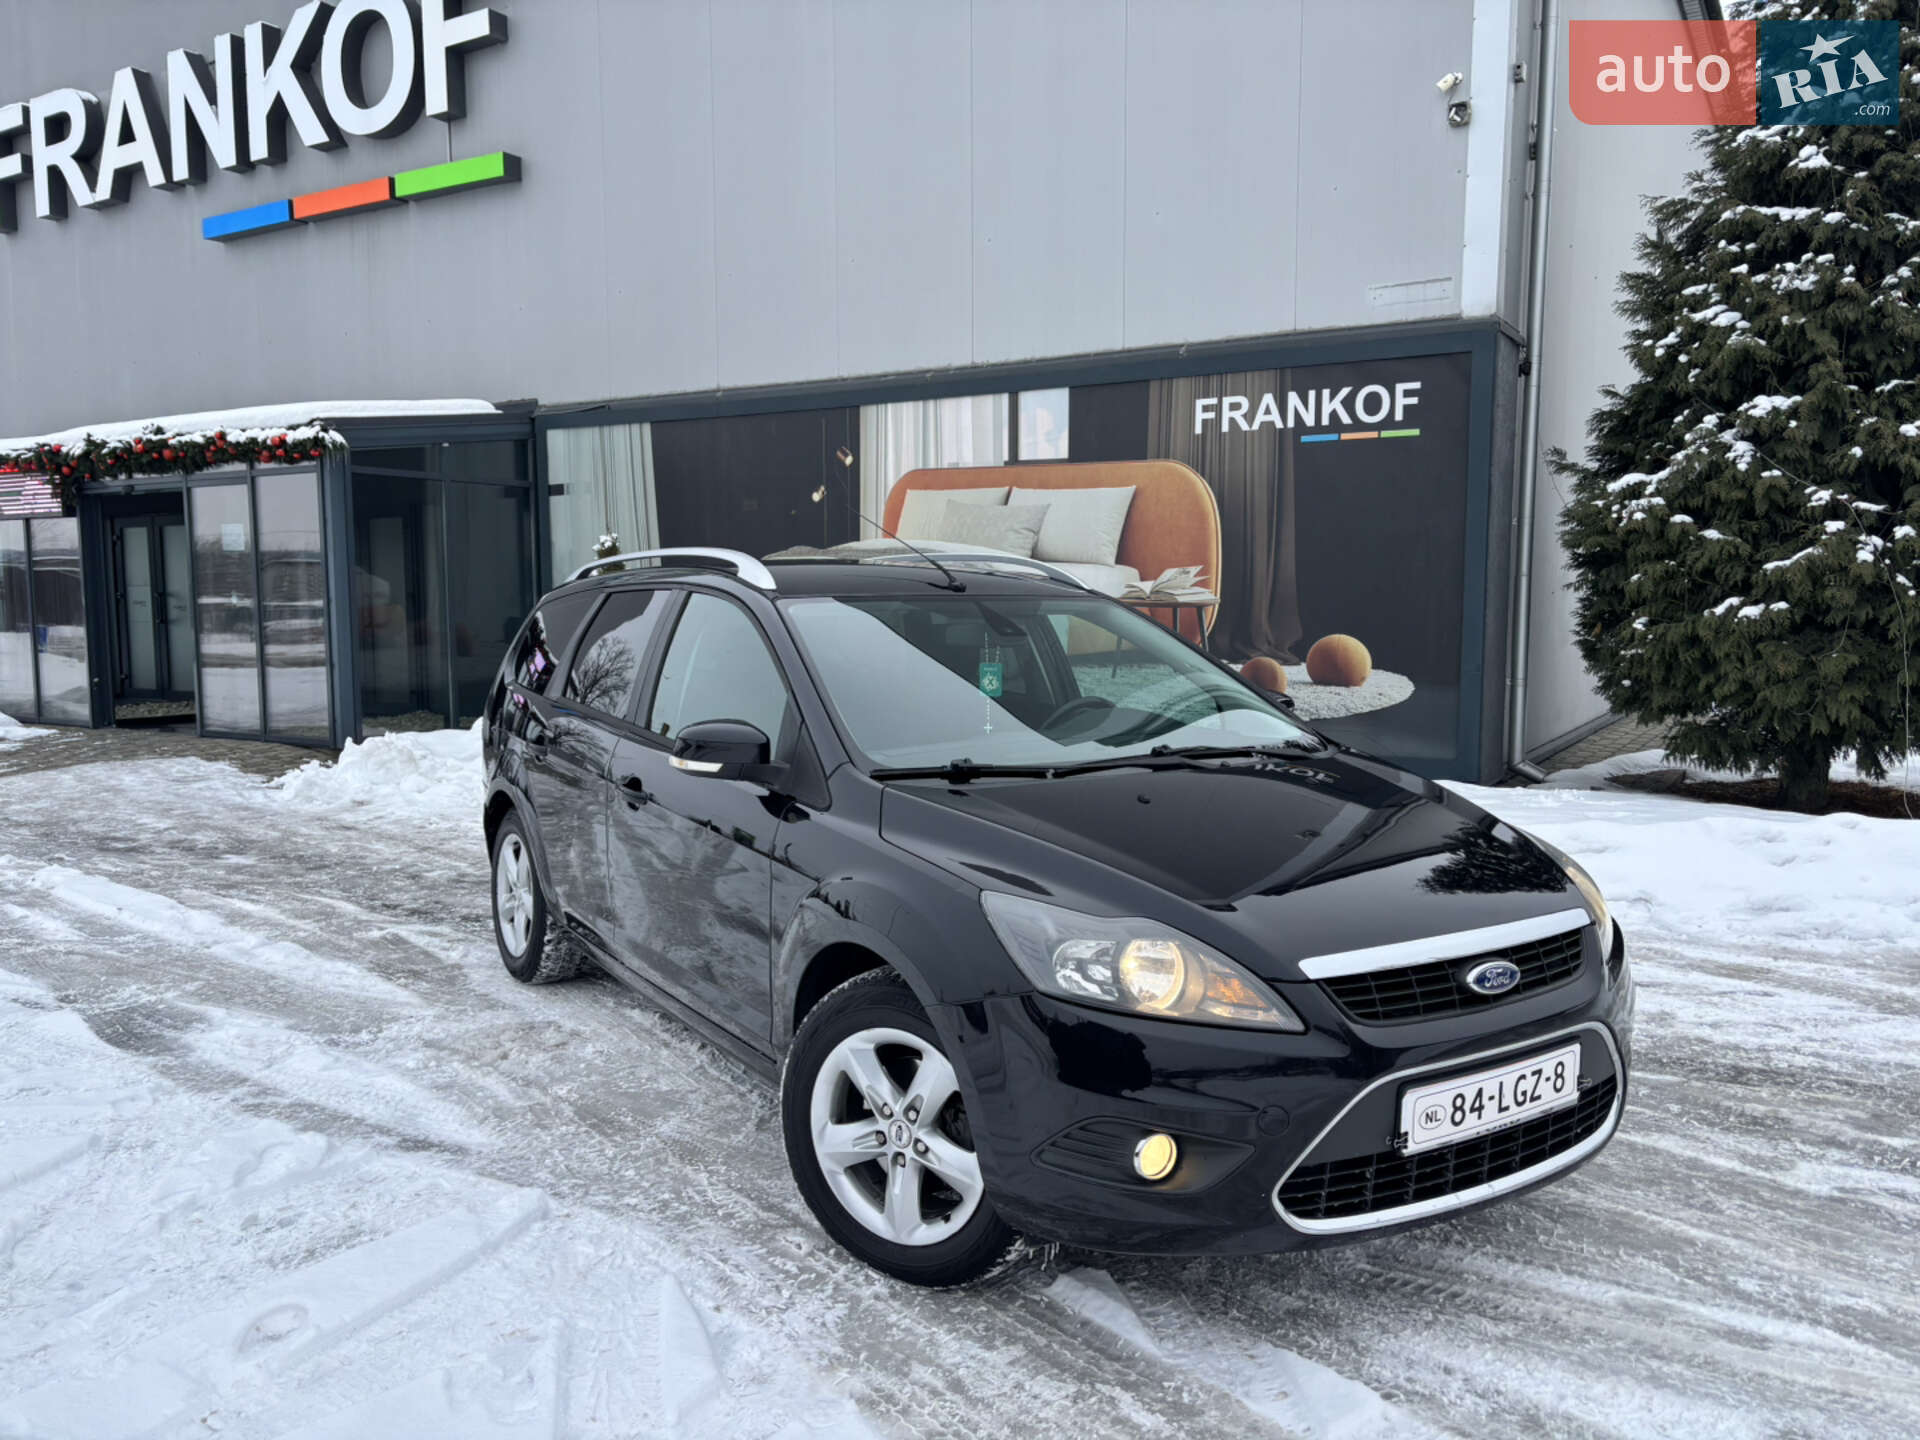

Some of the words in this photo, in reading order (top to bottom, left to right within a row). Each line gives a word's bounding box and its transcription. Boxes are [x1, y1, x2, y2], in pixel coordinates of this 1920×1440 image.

[1194, 381, 1422, 435] FRANKOF
[1484, 968, 1510, 987] Ford
[1424, 1110, 1441, 1125] NL
[1450, 1060, 1566, 1127] 84-LGZ-8
